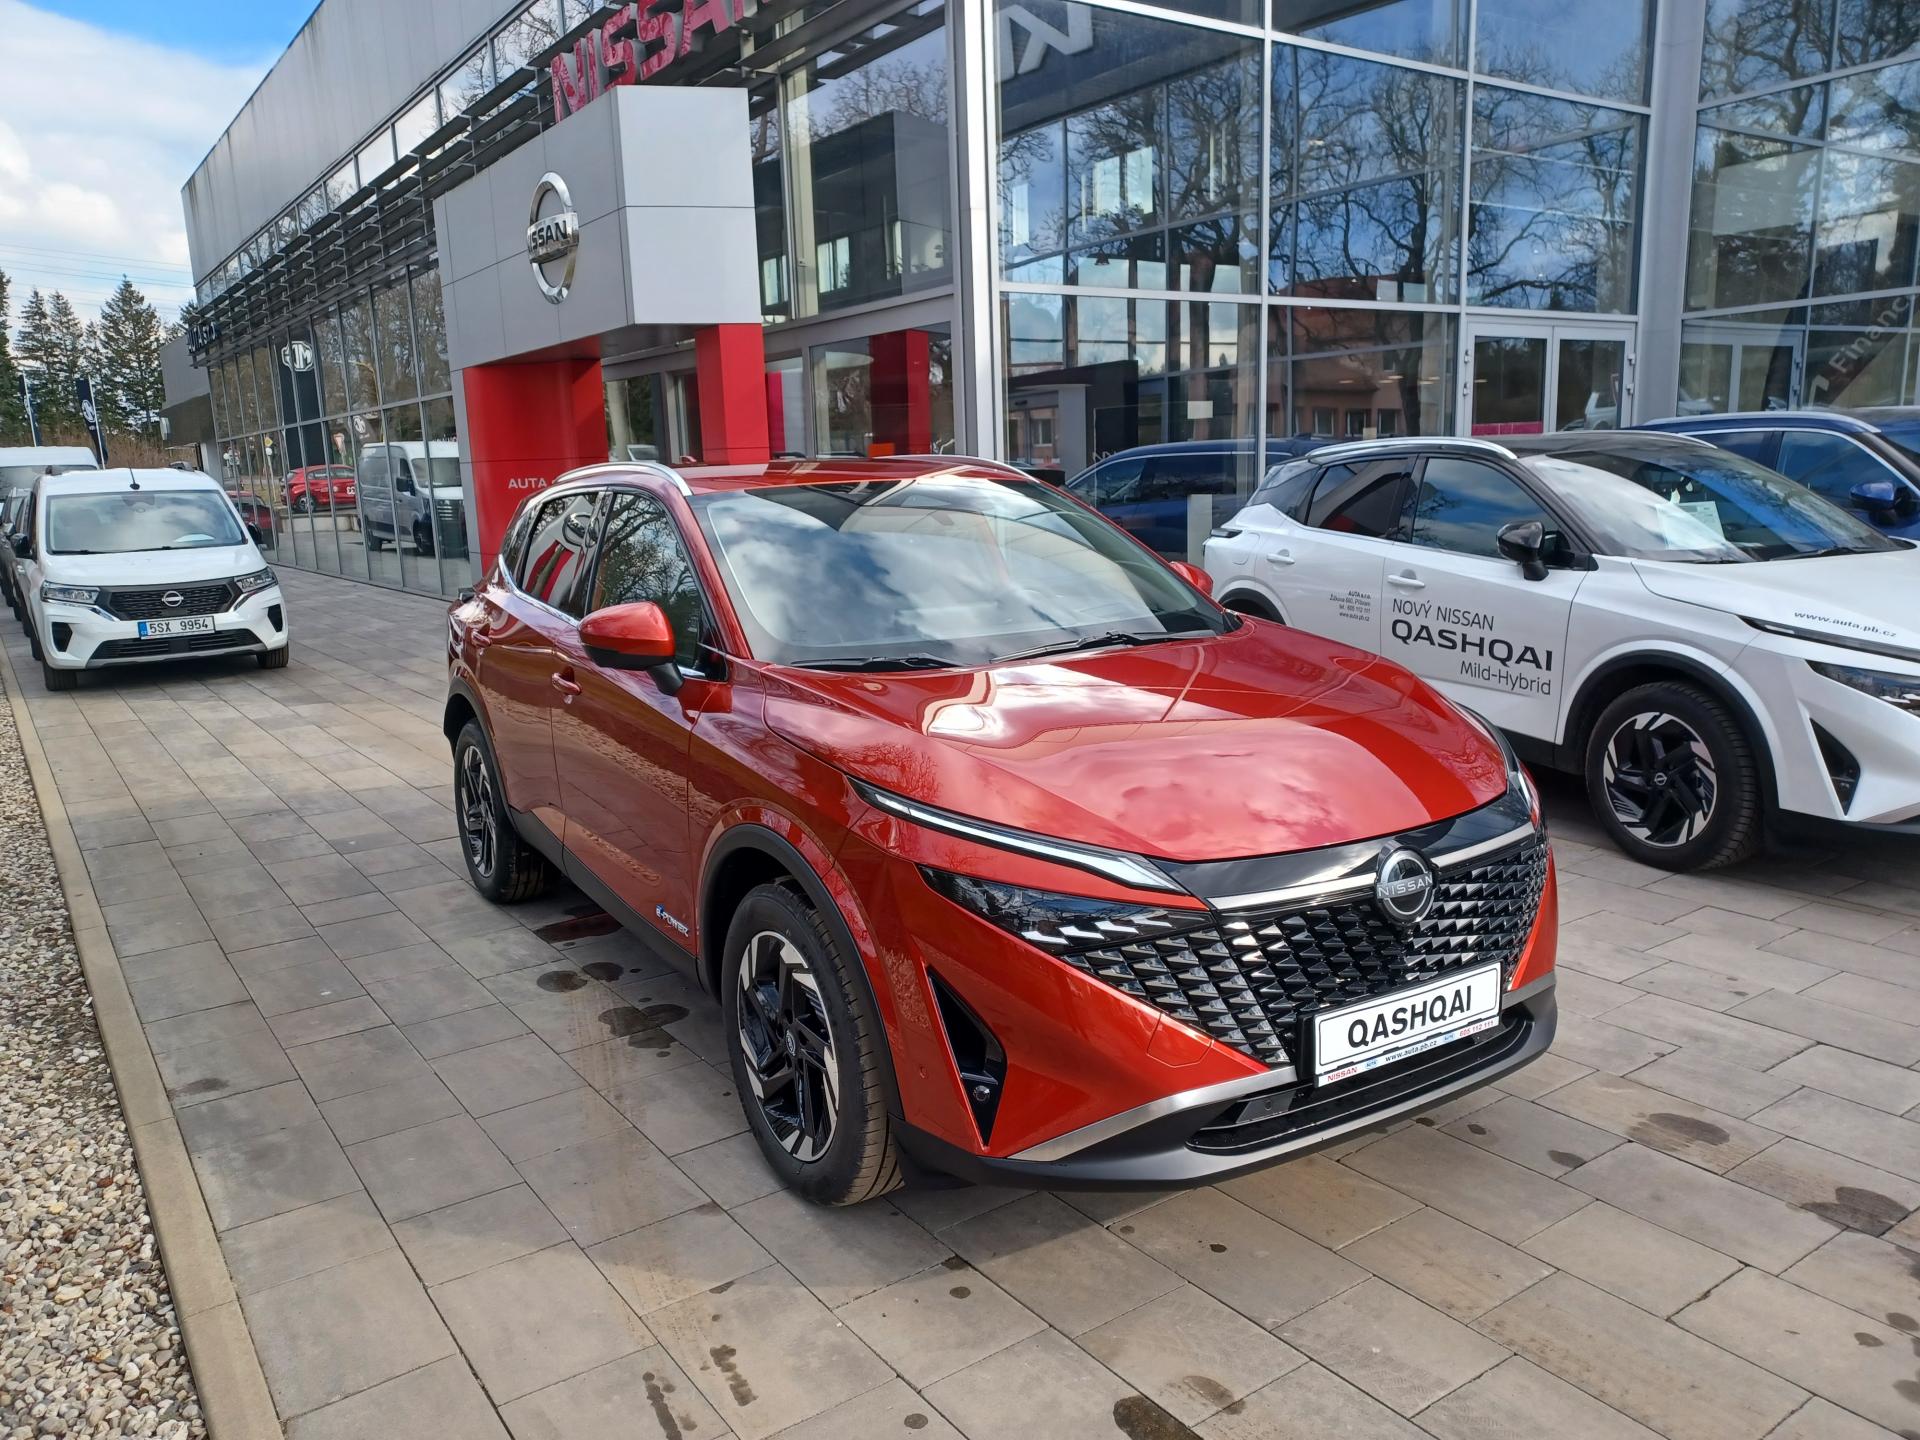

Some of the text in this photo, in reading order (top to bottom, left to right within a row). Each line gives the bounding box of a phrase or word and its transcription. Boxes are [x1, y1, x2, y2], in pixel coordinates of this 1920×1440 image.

[551, 0, 768, 123] NISSA
[1829, 296, 1910, 373] Financ
[508, 478, 547, 488] AUTA
[150, 619, 208, 633] 5SX 9954
[1392, 598, 1494, 631] NOVÝ NISSAN
[1794, 612, 1897, 637] www.auta.pb.cz
[1391, 619, 1553, 671] QASHQAI
[1460, 661, 1551, 695] Mild-Hybrid
[1378, 872, 1433, 897] NISSAN
[1348, 985, 1471, 1048] QASHQAI
[1327, 1066, 1358, 1082] NISSAN
[1385, 1041, 1437, 1062] www.auta.pb.cz
